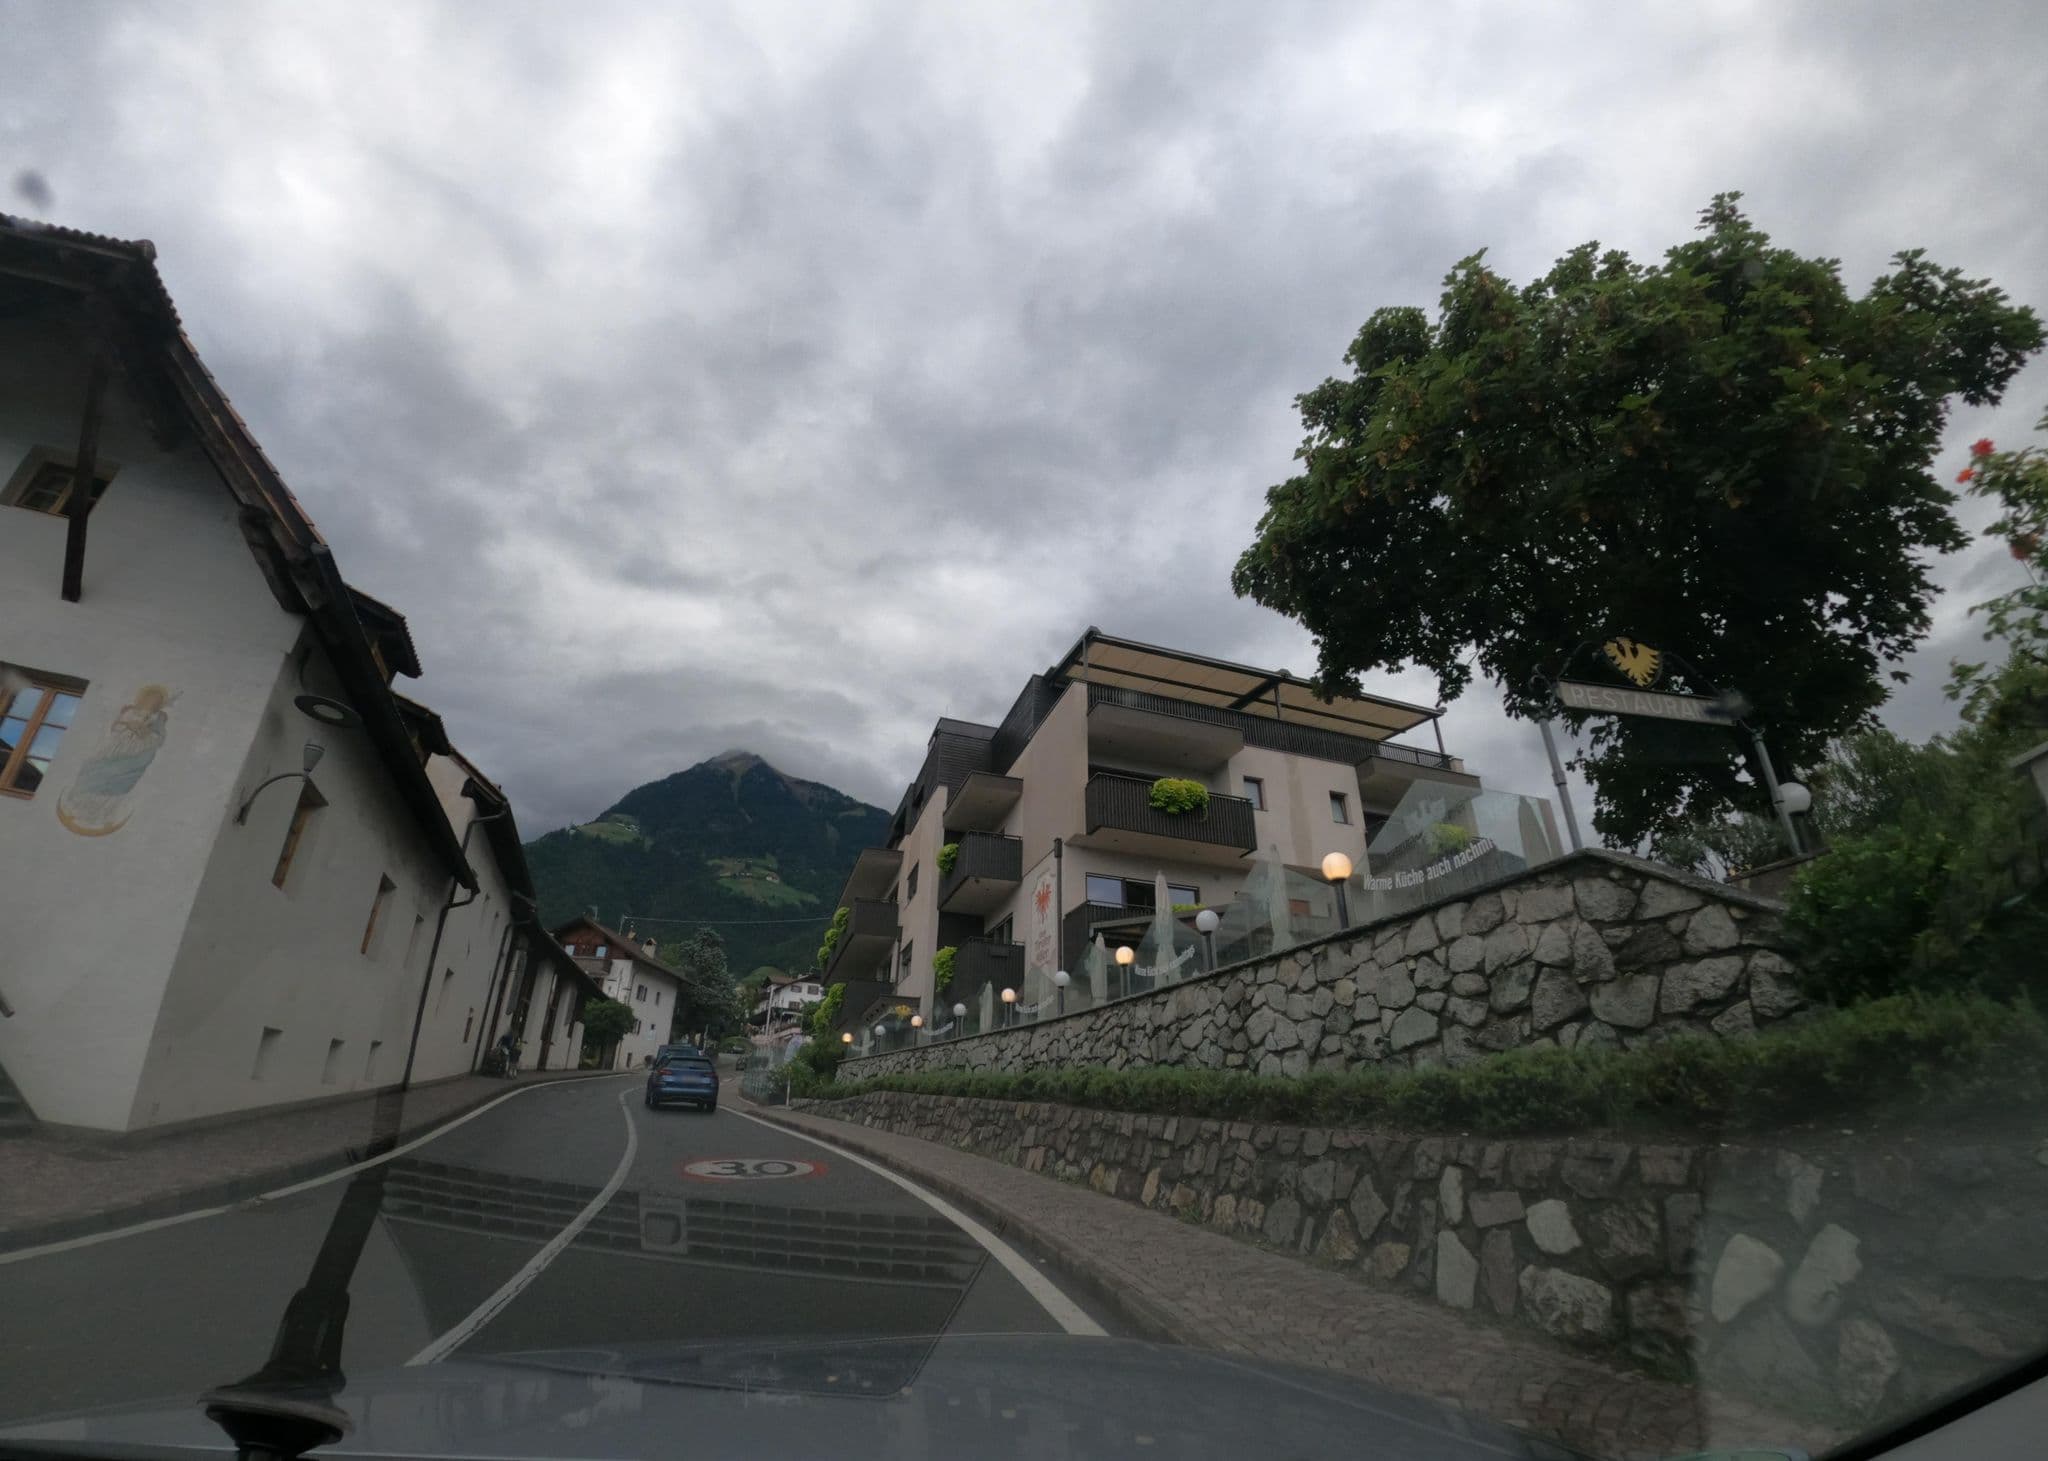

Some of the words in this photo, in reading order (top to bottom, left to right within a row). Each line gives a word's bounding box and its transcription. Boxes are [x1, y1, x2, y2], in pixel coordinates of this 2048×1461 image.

[1570, 685, 1722, 722] RESTAURA
[1363, 873, 1393, 891] Warme
[1395, 867, 1425, 889] Küche
[1426, 857, 1452, 880] auch
[705, 1160, 797, 1177] 30
